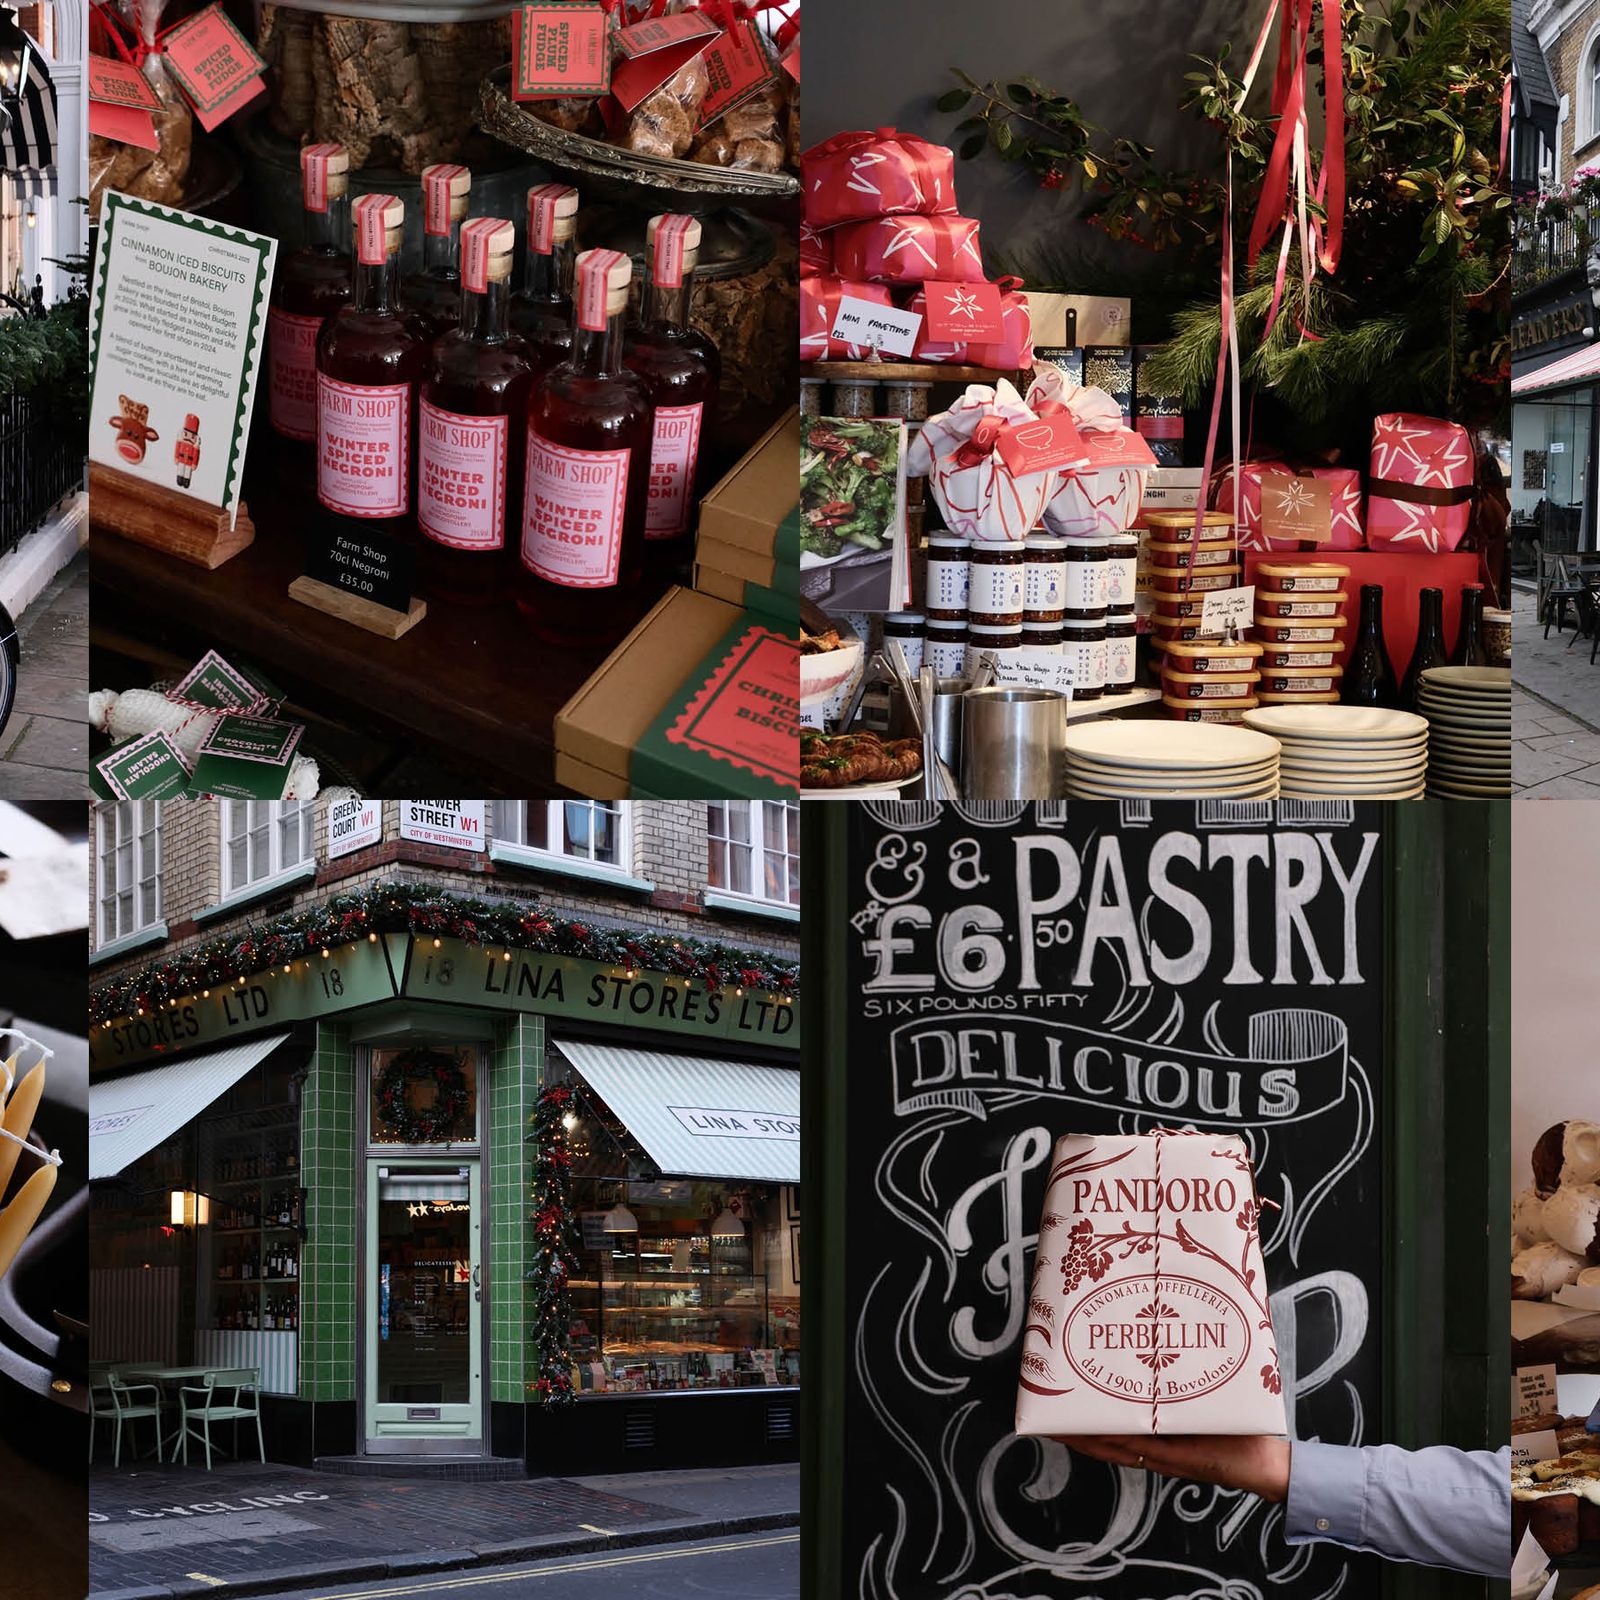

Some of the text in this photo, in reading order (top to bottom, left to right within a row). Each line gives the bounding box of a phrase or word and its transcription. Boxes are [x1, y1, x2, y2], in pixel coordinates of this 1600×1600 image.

[194, 44, 232, 75] SPICED
[535, 24, 547, 71] FUDGE
[547, 27, 558, 68] PLUM
[557, 22, 569, 73] SPICED
[95, 75, 139, 88] SPICED
[203, 55, 235, 80] PLUM
[207, 62, 244, 91] FUDGE
[711, 50, 732, 90] SPICED
[121, 236, 246, 285] CINNAMON ICED BISCUITS
[208, 245, 238, 261] CHRISTMAS
[149, 260, 188, 281] BOUJON
[189, 273, 228, 292] BAKERY
[140, 292, 152, 301] was
[153, 295, 179, 310] founded
[180, 305, 188, 313] by
[212, 314, 237, 328] Budgett
[153, 285, 164, 294] the
[164, 289, 181, 300] heart
[212, 304, 236, 317] Boujon
[139, 301, 155, 313] What
[156, 308, 178, 320] started
[215, 327, 238, 341] quickly
[162, 319, 185, 333] fledged
[186, 328, 210, 341] passion
[211, 336, 224, 346] and
[224, 340, 236, 350] she
[152, 326, 163, 335] her
[164, 330, 176, 340] first
[176, 335, 193, 347] shop
[200, 342, 217, 353] 2024
[156, 359, 169, 369] with
[175, 364, 188, 374] hint
[195, 373, 223, 388] warming
[163, 351, 197, 368] shortbread
[197, 363, 210, 372] and
[157, 368, 180, 382] biscuits
[180, 377, 191, 386] are
[192, 381, 200, 389] as
[200, 383, 230, 399] delightful
[162, 380, 176, 391] they
[177, 386, 187, 394] are
[188, 389, 195, 397] to
[321, 387, 396, 418] FARM SHOP
[325, 431, 390, 453] WINTER
[451, 428, 491, 449] SHOP
[654, 421, 688, 439] HOP
[323, 456, 393, 478] NEGRONI
[327, 447, 386, 465] SPICED
[424, 455, 485, 484] WINTER
[531, 448, 614, 485] FARM SHOP
[422, 481, 487, 509] NEGRONI
[424, 470, 479, 496] SPICED
[534, 493, 603, 520] WINTER
[534, 507, 597, 533] SPICED
[529, 517, 604, 546] NEGRONI
[330, 549, 390, 580] 70cl Negroni
[336, 536, 387, 564] Farm Shop
[339, 572, 374, 593] £35.00
[212, 677, 242, 706] SALAMI
[216, 736, 279, 750] CHOCOLATE
[225, 742, 265, 752] SALAMI
[124, 753, 171, 786] CHOCOLATE
[127, 751, 159, 774] SALAMI
[332, 810, 374, 838] COURT W1
[410, 807, 478, 833] STREET W1
[409, 829, 473, 847] CITY OF WESTMINSTER
[850, 900, 886, 935] FOR
[865, 831, 1380, 989] & a PASTRY
[423, 956, 795, 1035] 18 LINA STORES LTD
[863, 994, 1089, 1018] SIX POUNDS FIFTY
[111, 968, 345, 1055] STORES LTD 18
[910, 1029, 1302, 1118] DELICIOUS
[689, 1114, 748, 1132] LINA
[1072, 1177, 1237, 1214] PANDORO
[1082, 1281, 1149, 1318] RINOMATA
[1088, 1322, 1227, 1350] PERBELLINI
[1081, 1355, 1236, 1396] dal 1900 in Bovolone
